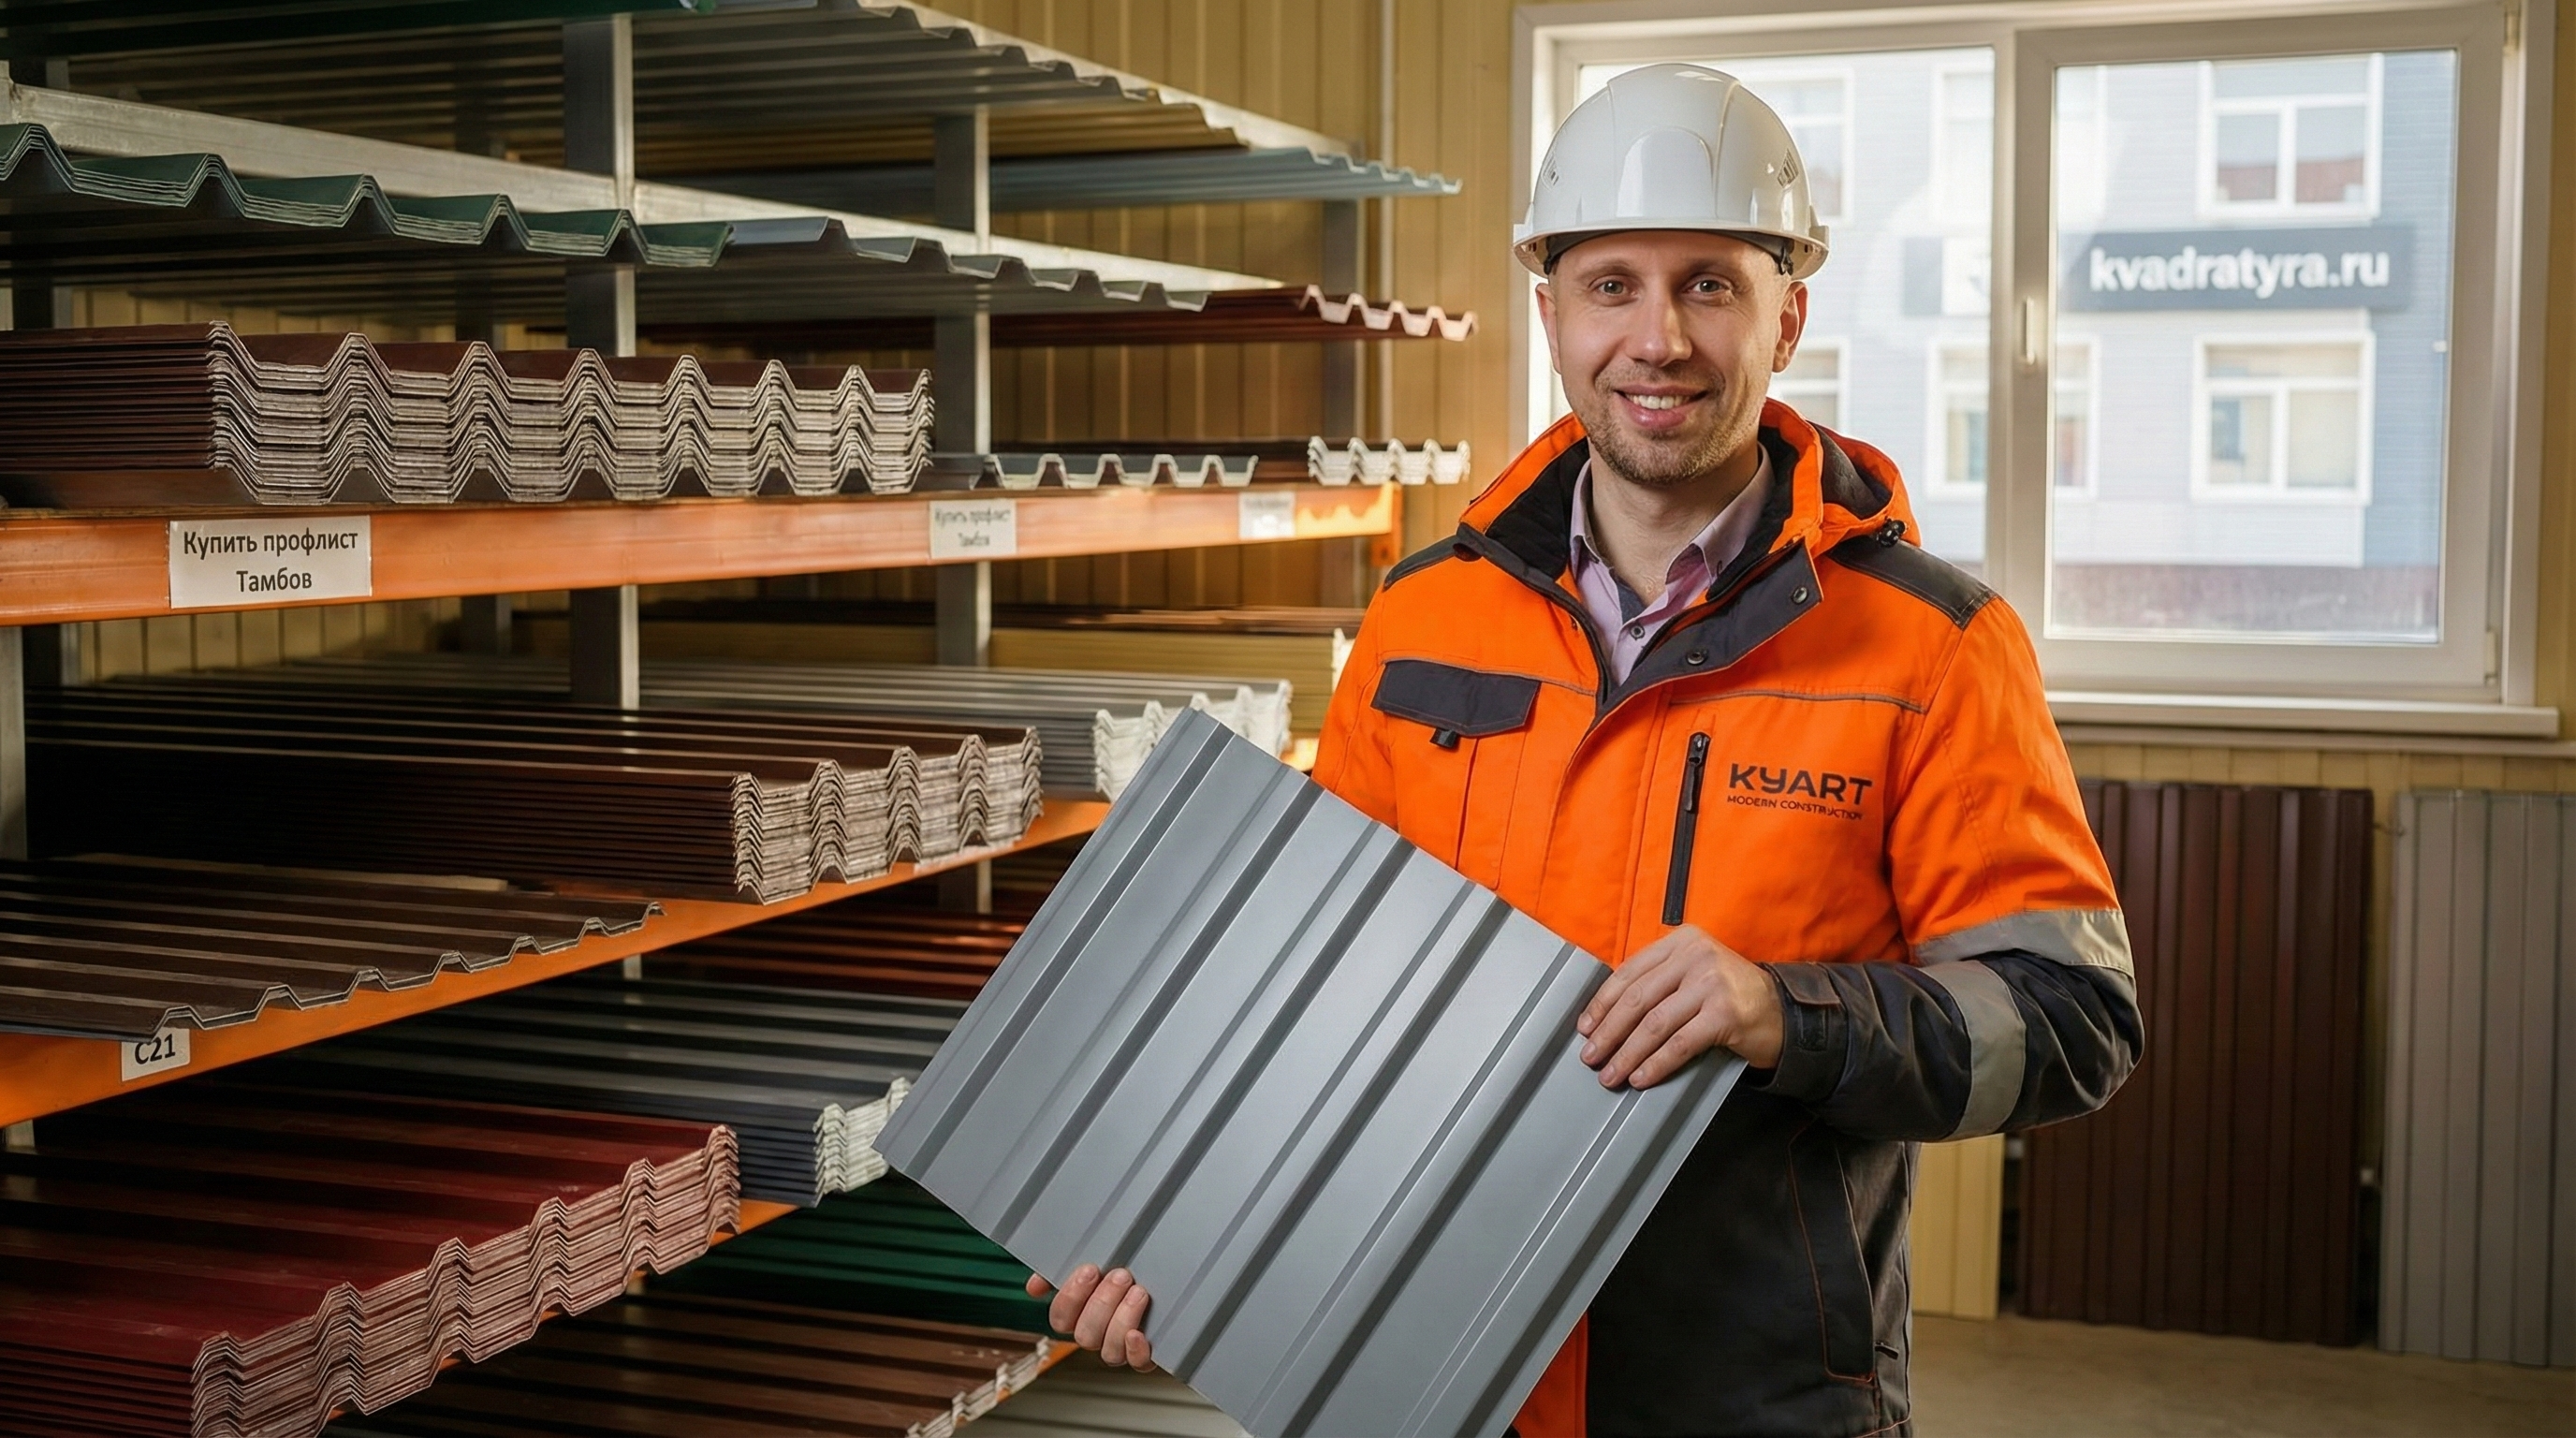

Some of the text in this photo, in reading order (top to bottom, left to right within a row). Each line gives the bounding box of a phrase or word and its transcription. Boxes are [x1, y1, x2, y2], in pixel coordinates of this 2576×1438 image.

[2089, 245, 2390, 300] kvadratyra.ru
[183, 526, 359, 561] Купить профлист
[236, 566, 313, 593] Тамбов
[1727, 795, 1778, 808] MODERN
[1729, 763, 1873, 806] KYART
